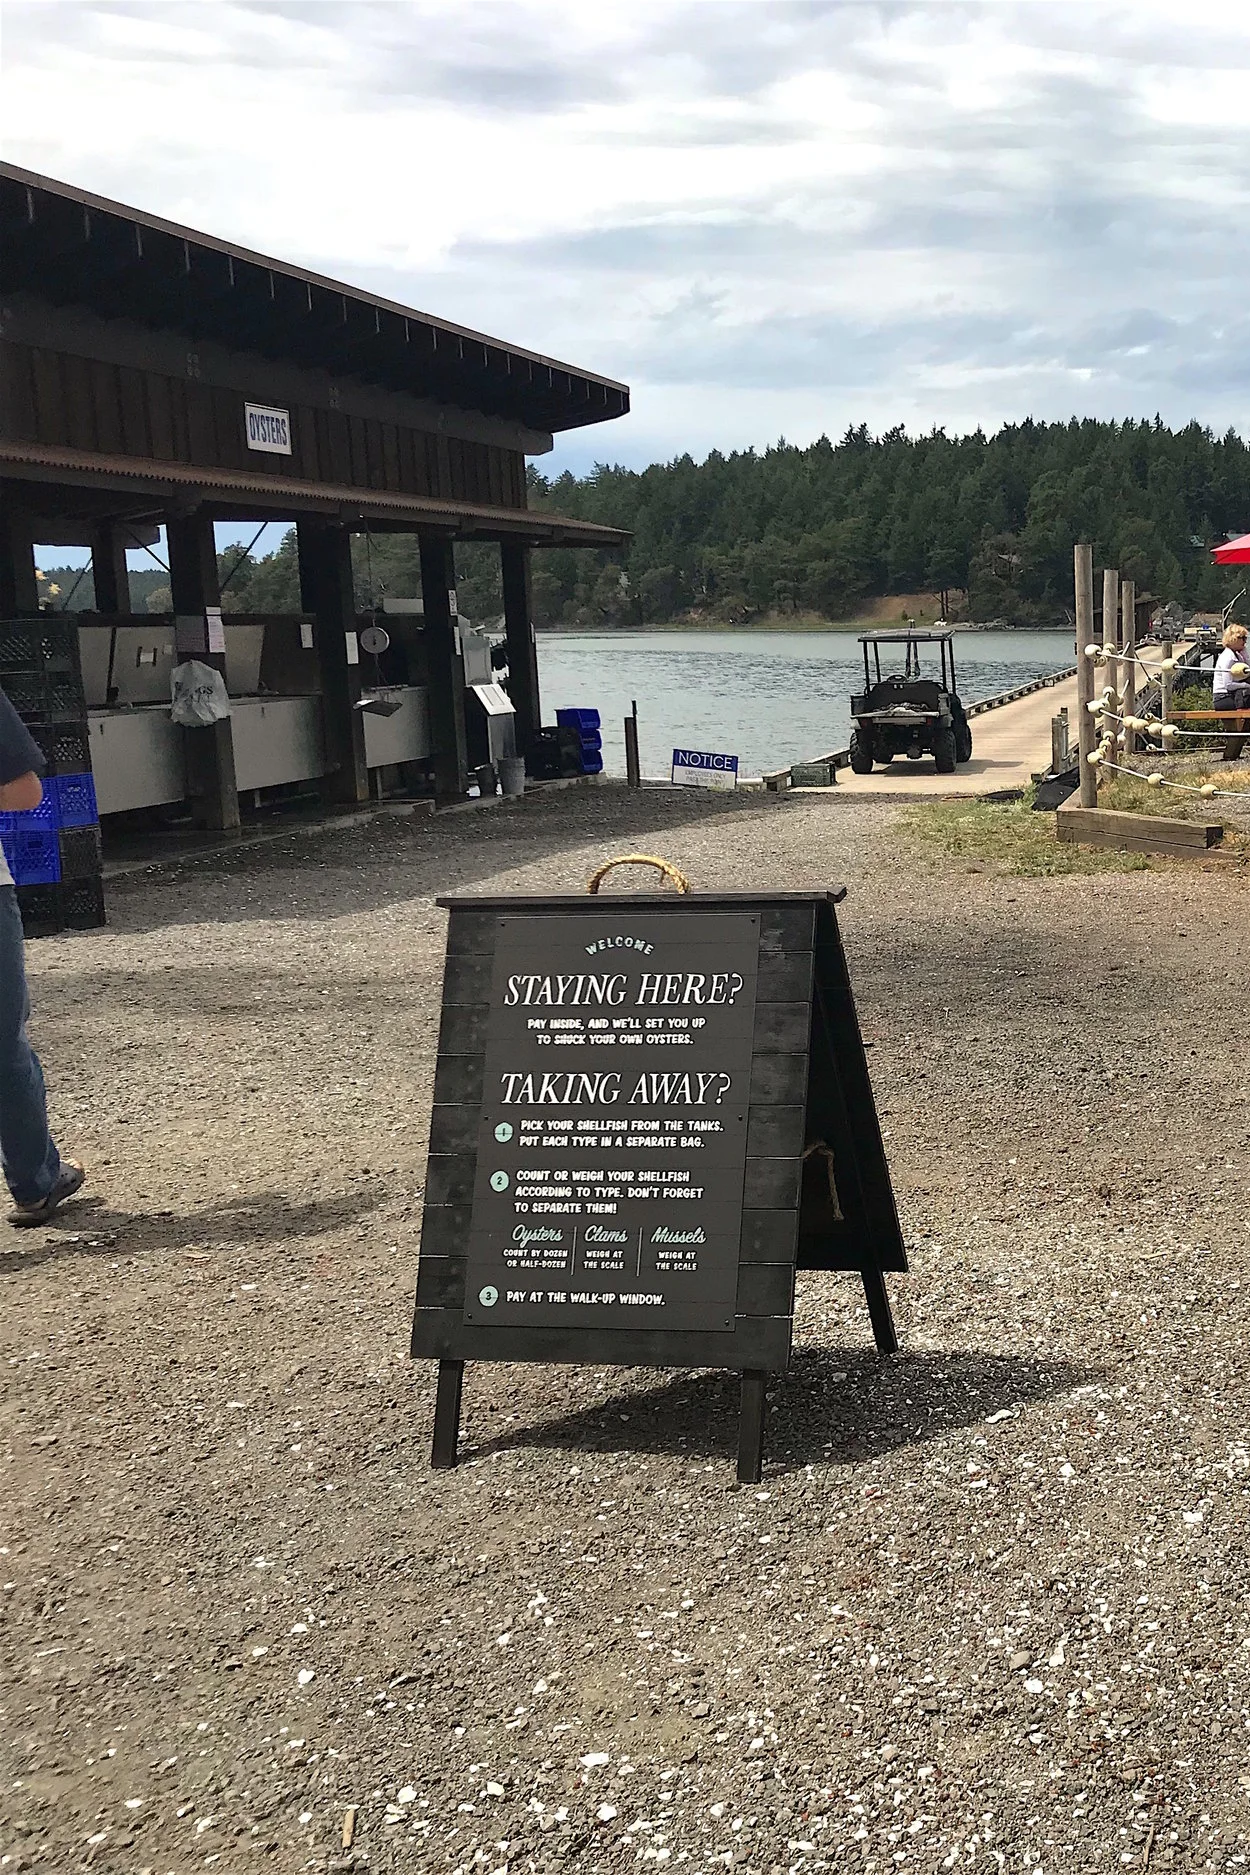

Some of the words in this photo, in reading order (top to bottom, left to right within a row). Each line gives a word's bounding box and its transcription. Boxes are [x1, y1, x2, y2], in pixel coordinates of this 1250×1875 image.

[249, 412, 288, 446] OYSTERS
[678, 751, 732, 770] NOTICE
[583, 936, 655, 956] WELCOME
[503, 974, 628, 1006] STAYING
[634, 973, 744, 1005] HERE?
[527, 1018, 548, 1030] PAY
[549, 1018, 585, 1031] INSIDE,
[587, 1018, 610, 1029] AND
[612, 1016, 642, 1029] WE'LL
[645, 1017, 665, 1029] SET
[668, 1017, 689, 1029] YOU
[691, 1017, 706, 1029] UP
[537, 1034, 552, 1045] TO
[554, 1034, 587, 1045] SHUCK
[589, 1034, 617, 1045] YOUR
[619, 1034, 644, 1045] OWN
[646, 1034, 694, 1045] OYSTERS.
[501, 1072, 622, 1105] TAKING
[627, 1072, 732, 1105] AWAY?
[520, 1119, 545, 1131] PICK
[547, 1119, 574, 1131] YOUR
[576, 1119, 629, 1132] SHELLFISH
[631, 1119, 661, 1132] FROM
[664, 1120, 684, 1132] THE
[687, 1120, 724, 1132] TANKS.
[519, 1135, 540, 1147] PUT
[542, 1135, 569, 1147] EACH
[572, 1135, 599, 1147] TYPE
[601, 1136, 613, 1147] IN
[615, 1136, 623, 1147] A
[626, 1136, 678, 1148] SEPARATE
[681, 1136, 705, 1148] BAG.
[516, 1170, 551, 1182] COUNT
[554, 1170, 569, 1182] OR
[572, 1170, 605, 1182] WEIGH
[608, 1170, 635, 1182] YOUR
[638, 1170, 690, 1183] SHELLFISH
[515, 1186, 573, 1198] ACCORDING
[576, 1186, 591, 1198] TO
[594, 1187, 625, 1199] TYPE.
[627, 1186, 661, 1199] DON'T
[663, 1187, 704, 1199] FORGET
[514, 1202, 529, 1213] TO
[532, 1202, 583, 1214] SEPARATE
[586, 1203, 617, 1215] THEM!
[512, 1224, 564, 1248] Oysters
[584, 1224, 629, 1243] Clams
[650, 1226, 707, 1244] Mussels
[503, 1249, 529, 1258] COUNT
[531, 1249, 542, 1258] BY
[544, 1249, 569, 1259] DOZEN
[586, 1250, 611, 1259] WEIGH
[613, 1251, 624, 1259] AT
[658, 1251, 683, 1260] WEIGH
[686, 1251, 697, 1260] AT
[506, 1259, 518, 1268] OR
[520, 1259, 567, 1270] HALF-DOZEN
[583, 1260, 598, 1270] THE
[601, 1261, 625, 1270] SCALE
[656, 1261, 671, 1271] THE
[673, 1261, 698, 1271] SCALE
[506, 1291, 527, 1303] PAY
[529, 1291, 544, 1303] AT
[547, 1292, 567, 1304] THE
[570, 1292, 616, 1305] WALK-UP
[618, 1293, 666, 1306] WINDOW.
